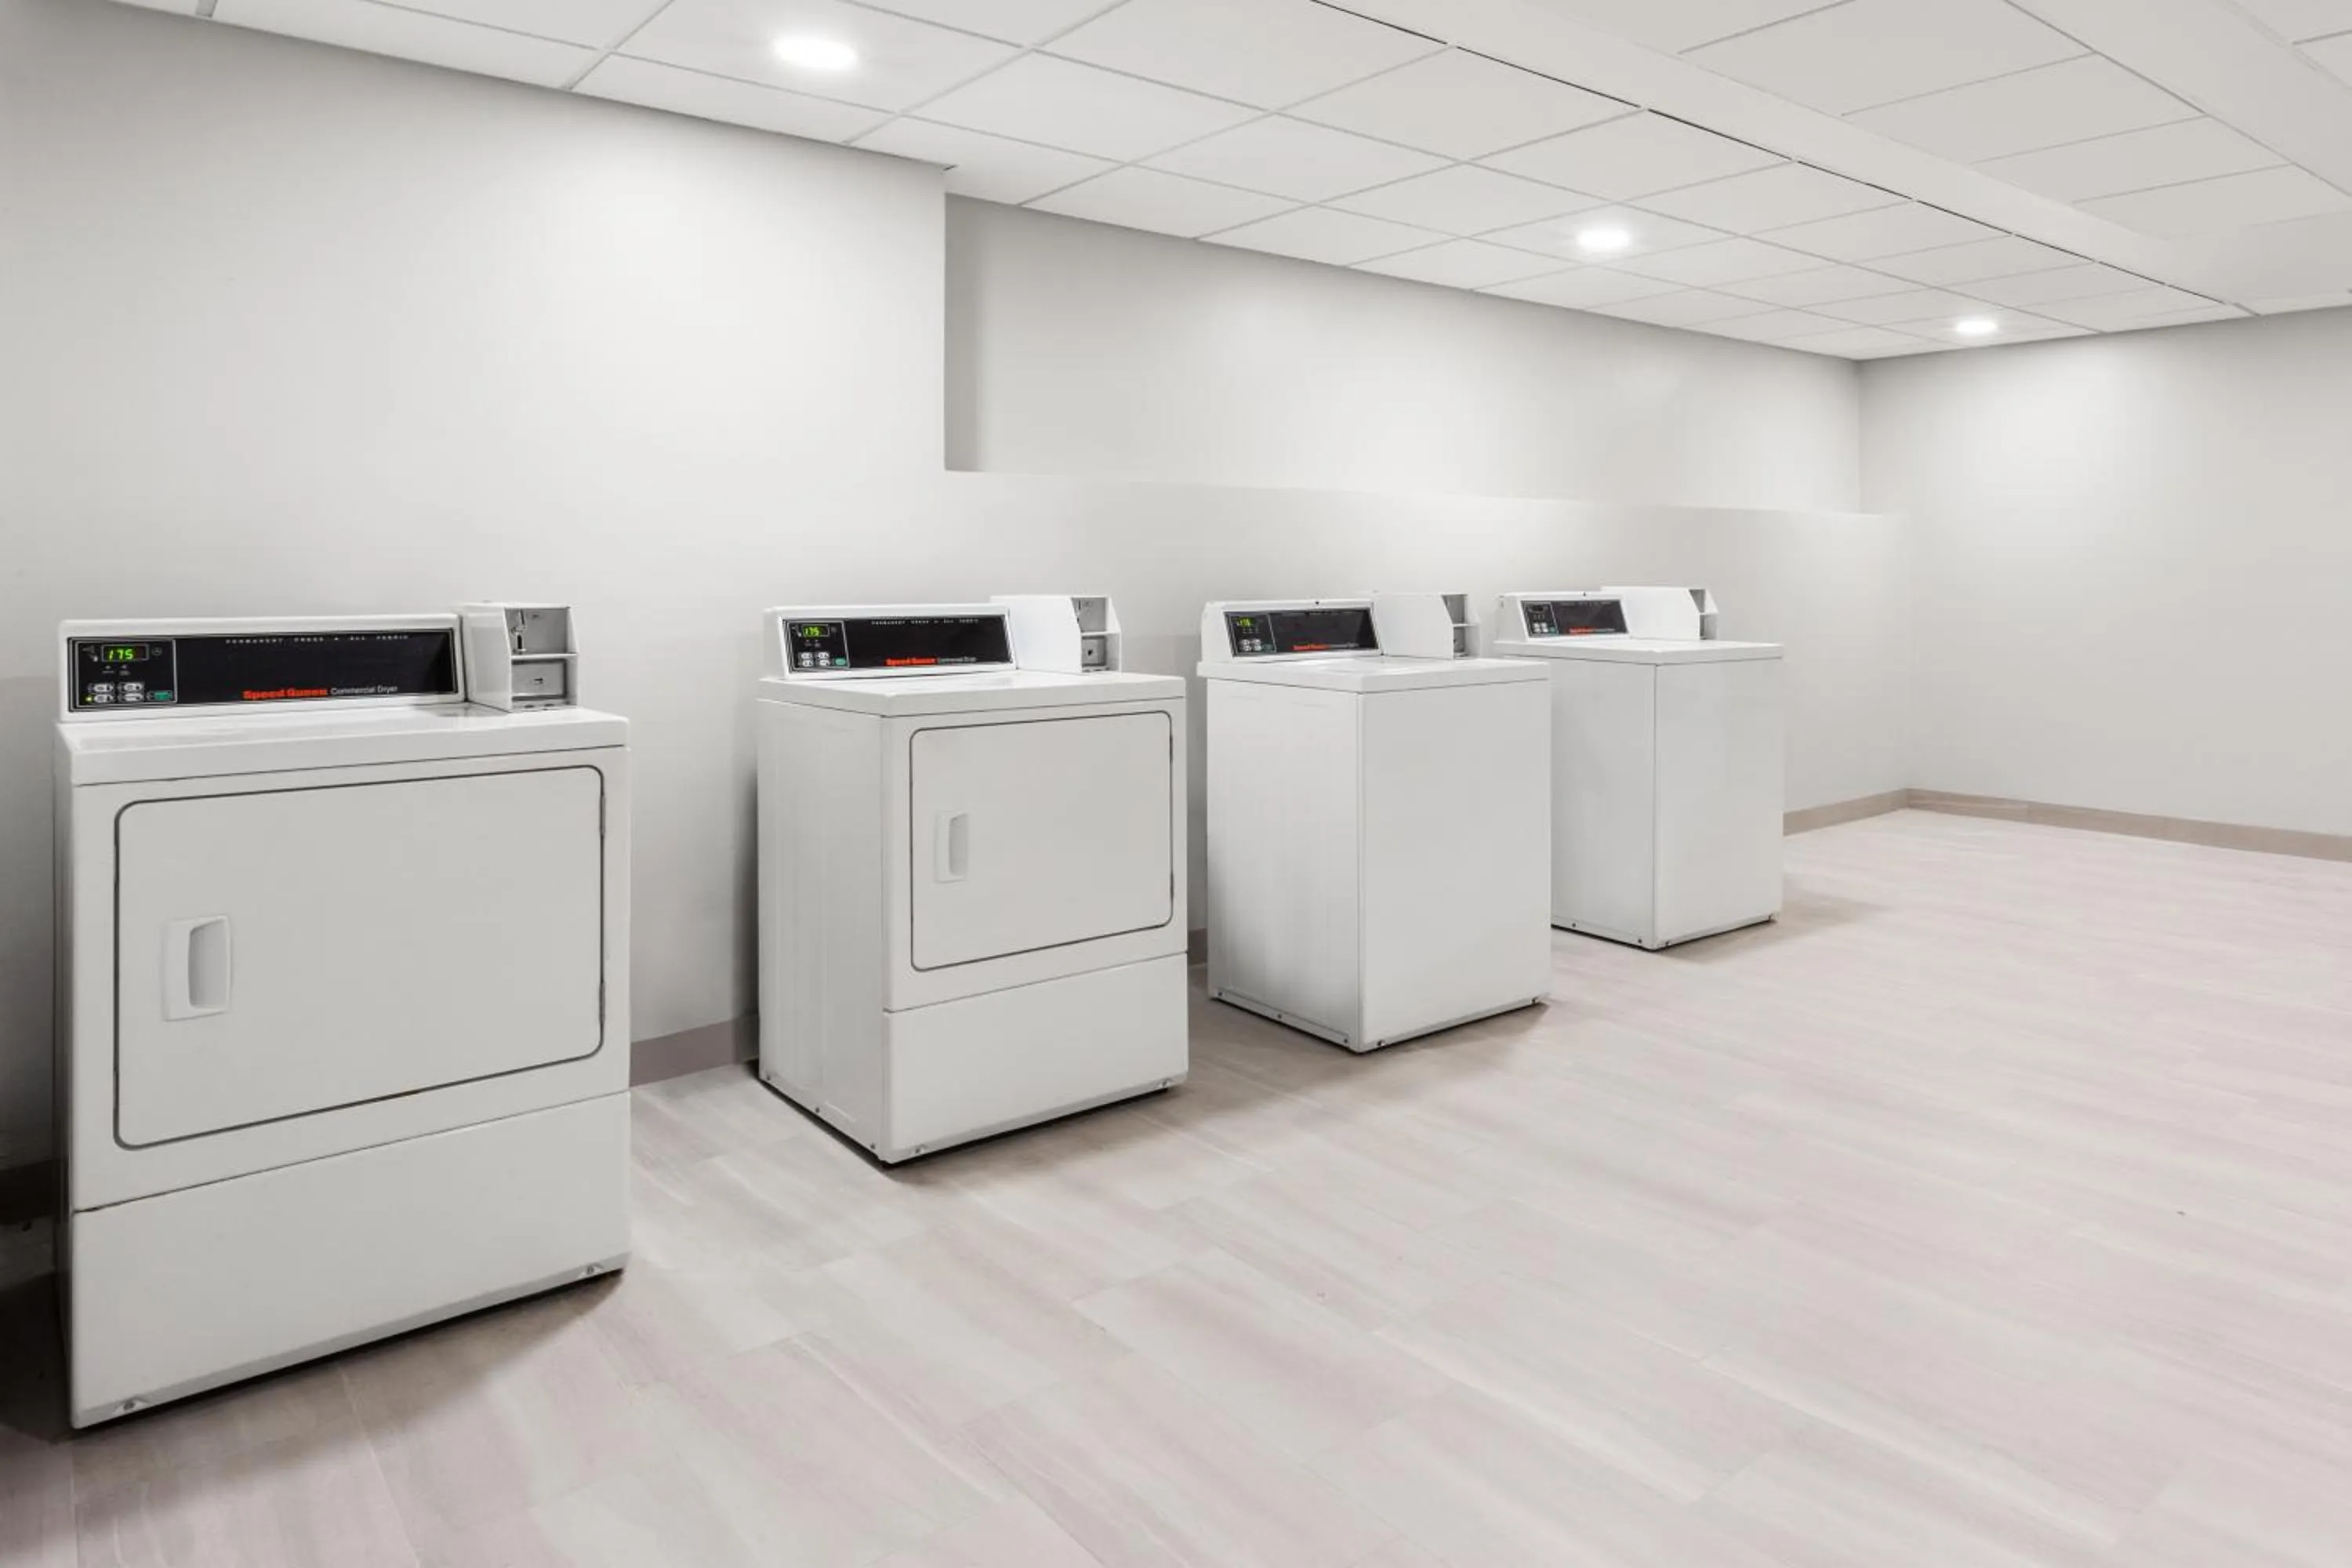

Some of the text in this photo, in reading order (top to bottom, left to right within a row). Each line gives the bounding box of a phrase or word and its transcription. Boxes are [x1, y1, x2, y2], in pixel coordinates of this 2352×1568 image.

[107, 648, 134, 660] 175
[242, 684, 397, 700] Speed Queen Commercial Dryer
